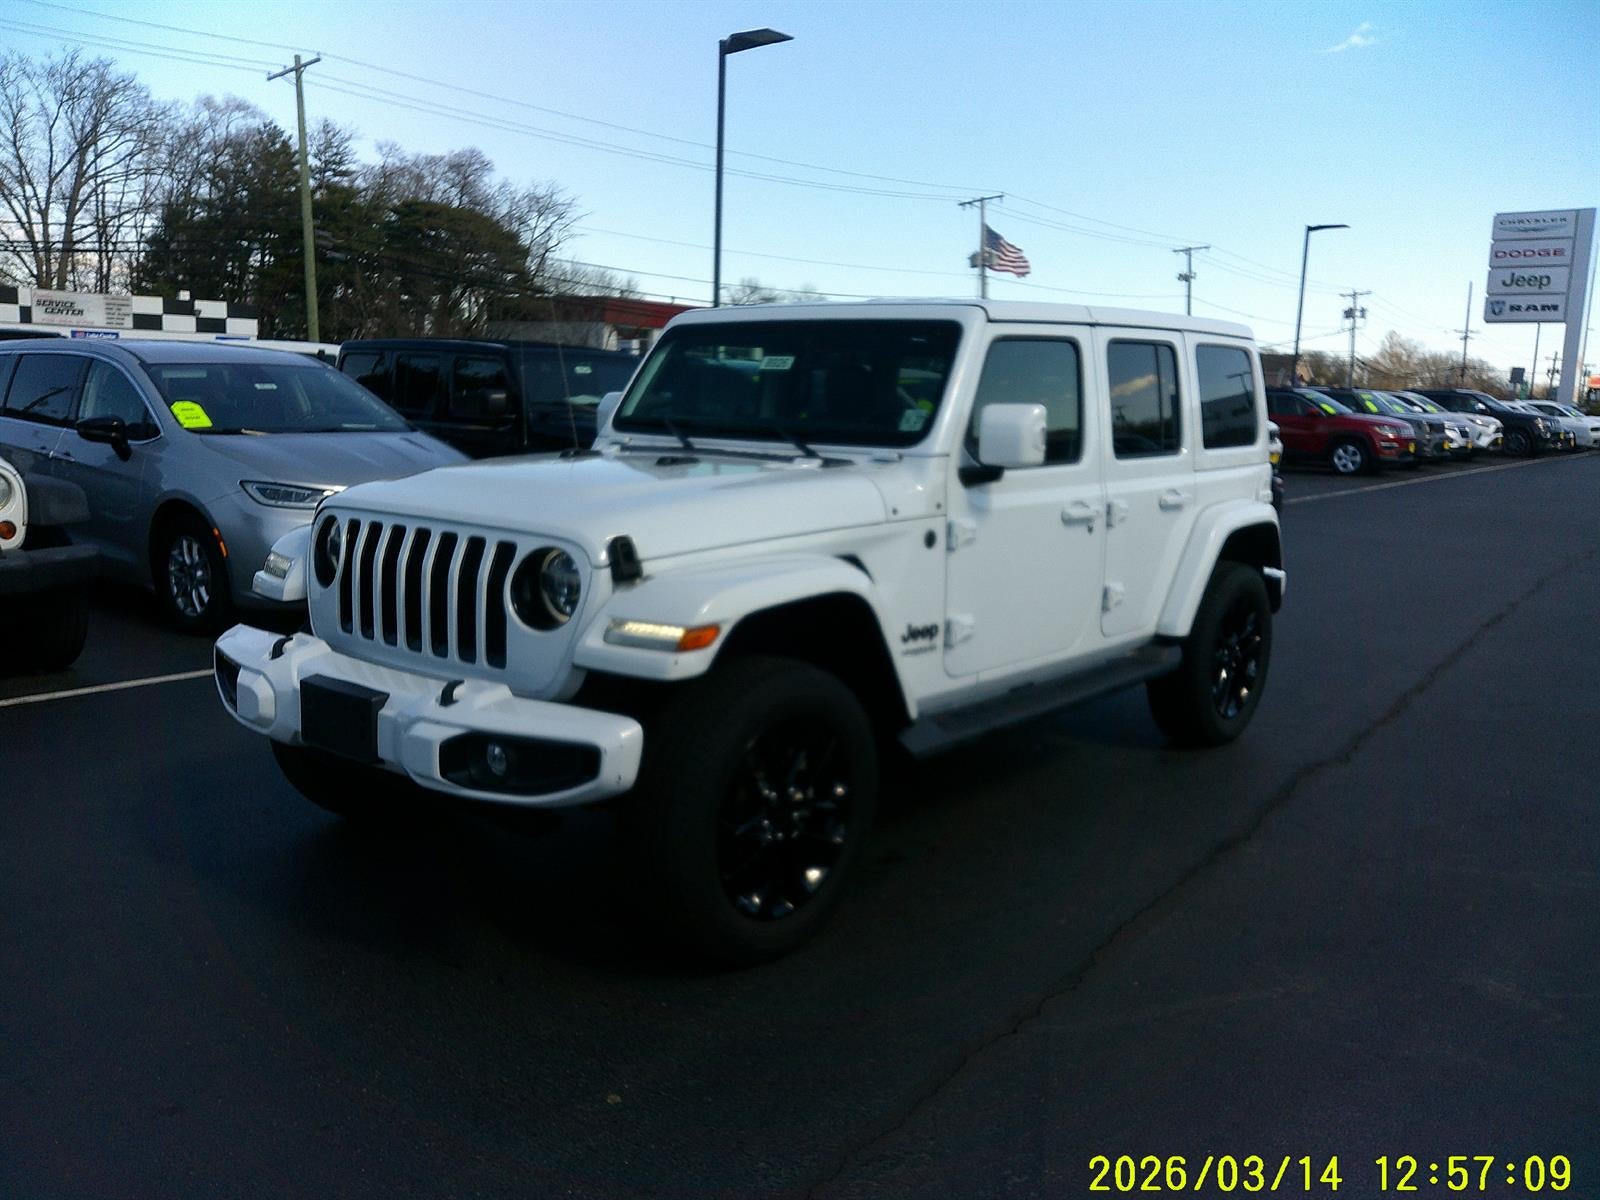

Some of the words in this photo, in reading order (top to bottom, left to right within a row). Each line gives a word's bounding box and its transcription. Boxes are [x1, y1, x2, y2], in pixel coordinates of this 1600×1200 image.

[1494, 247, 1565, 260] DODGE
[1501, 271, 1552, 290] Jeep
[35, 298, 76, 309] SERVICE
[1508, 303, 1559, 313] RAM
[44, 306, 85, 317] CENTER
[901, 622, 939, 644] Jeep
